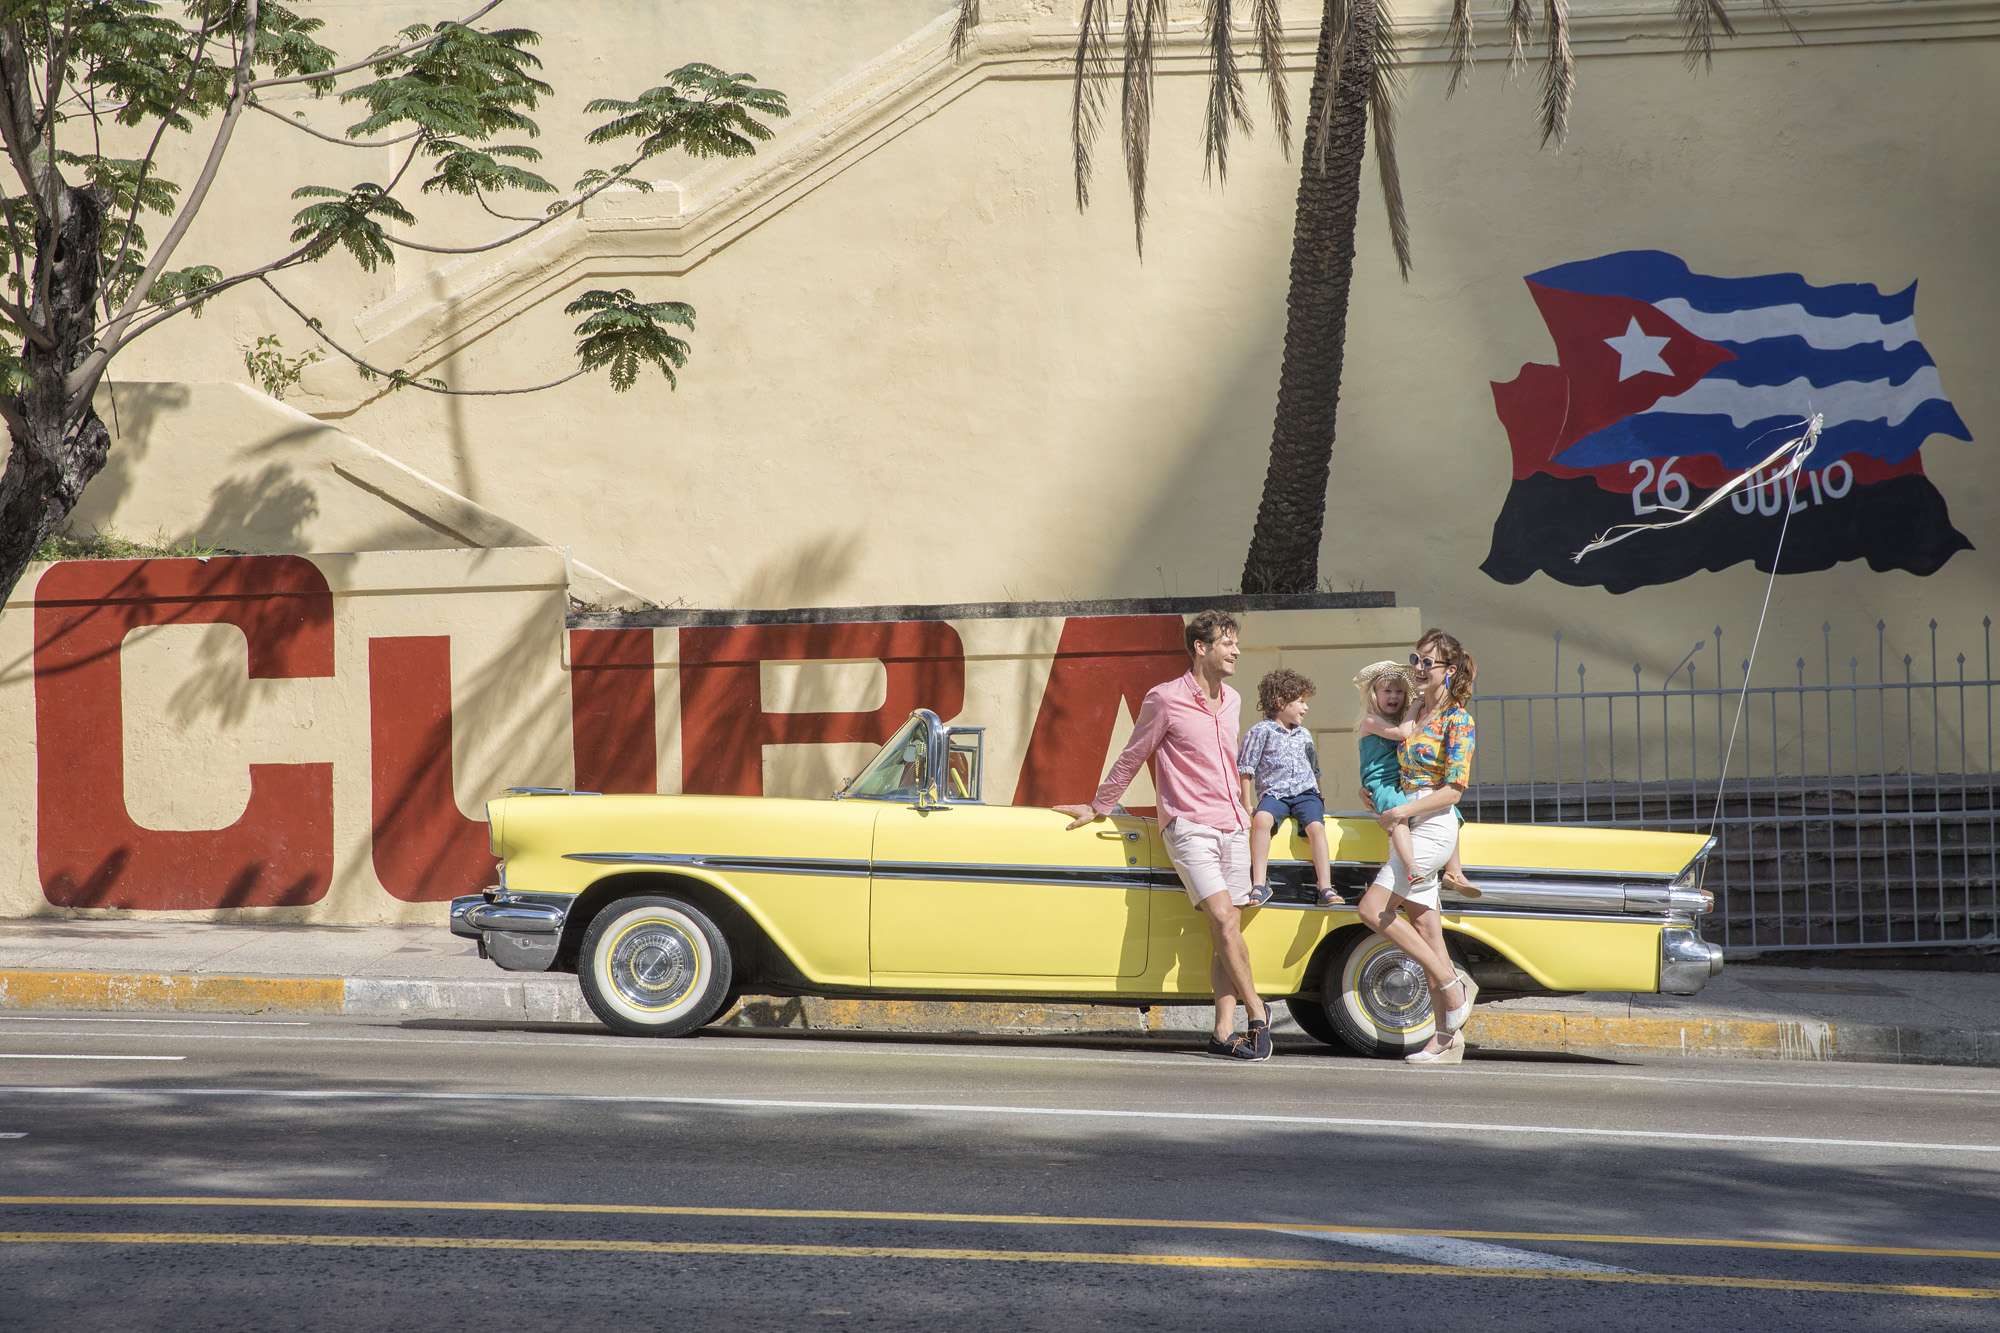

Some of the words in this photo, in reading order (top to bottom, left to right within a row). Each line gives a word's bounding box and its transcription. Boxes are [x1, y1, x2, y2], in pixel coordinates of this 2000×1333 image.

[1628, 456, 1690, 516] 26
[1731, 459, 1854, 517] JULIO
[34, 554, 1187, 910] CUBA
